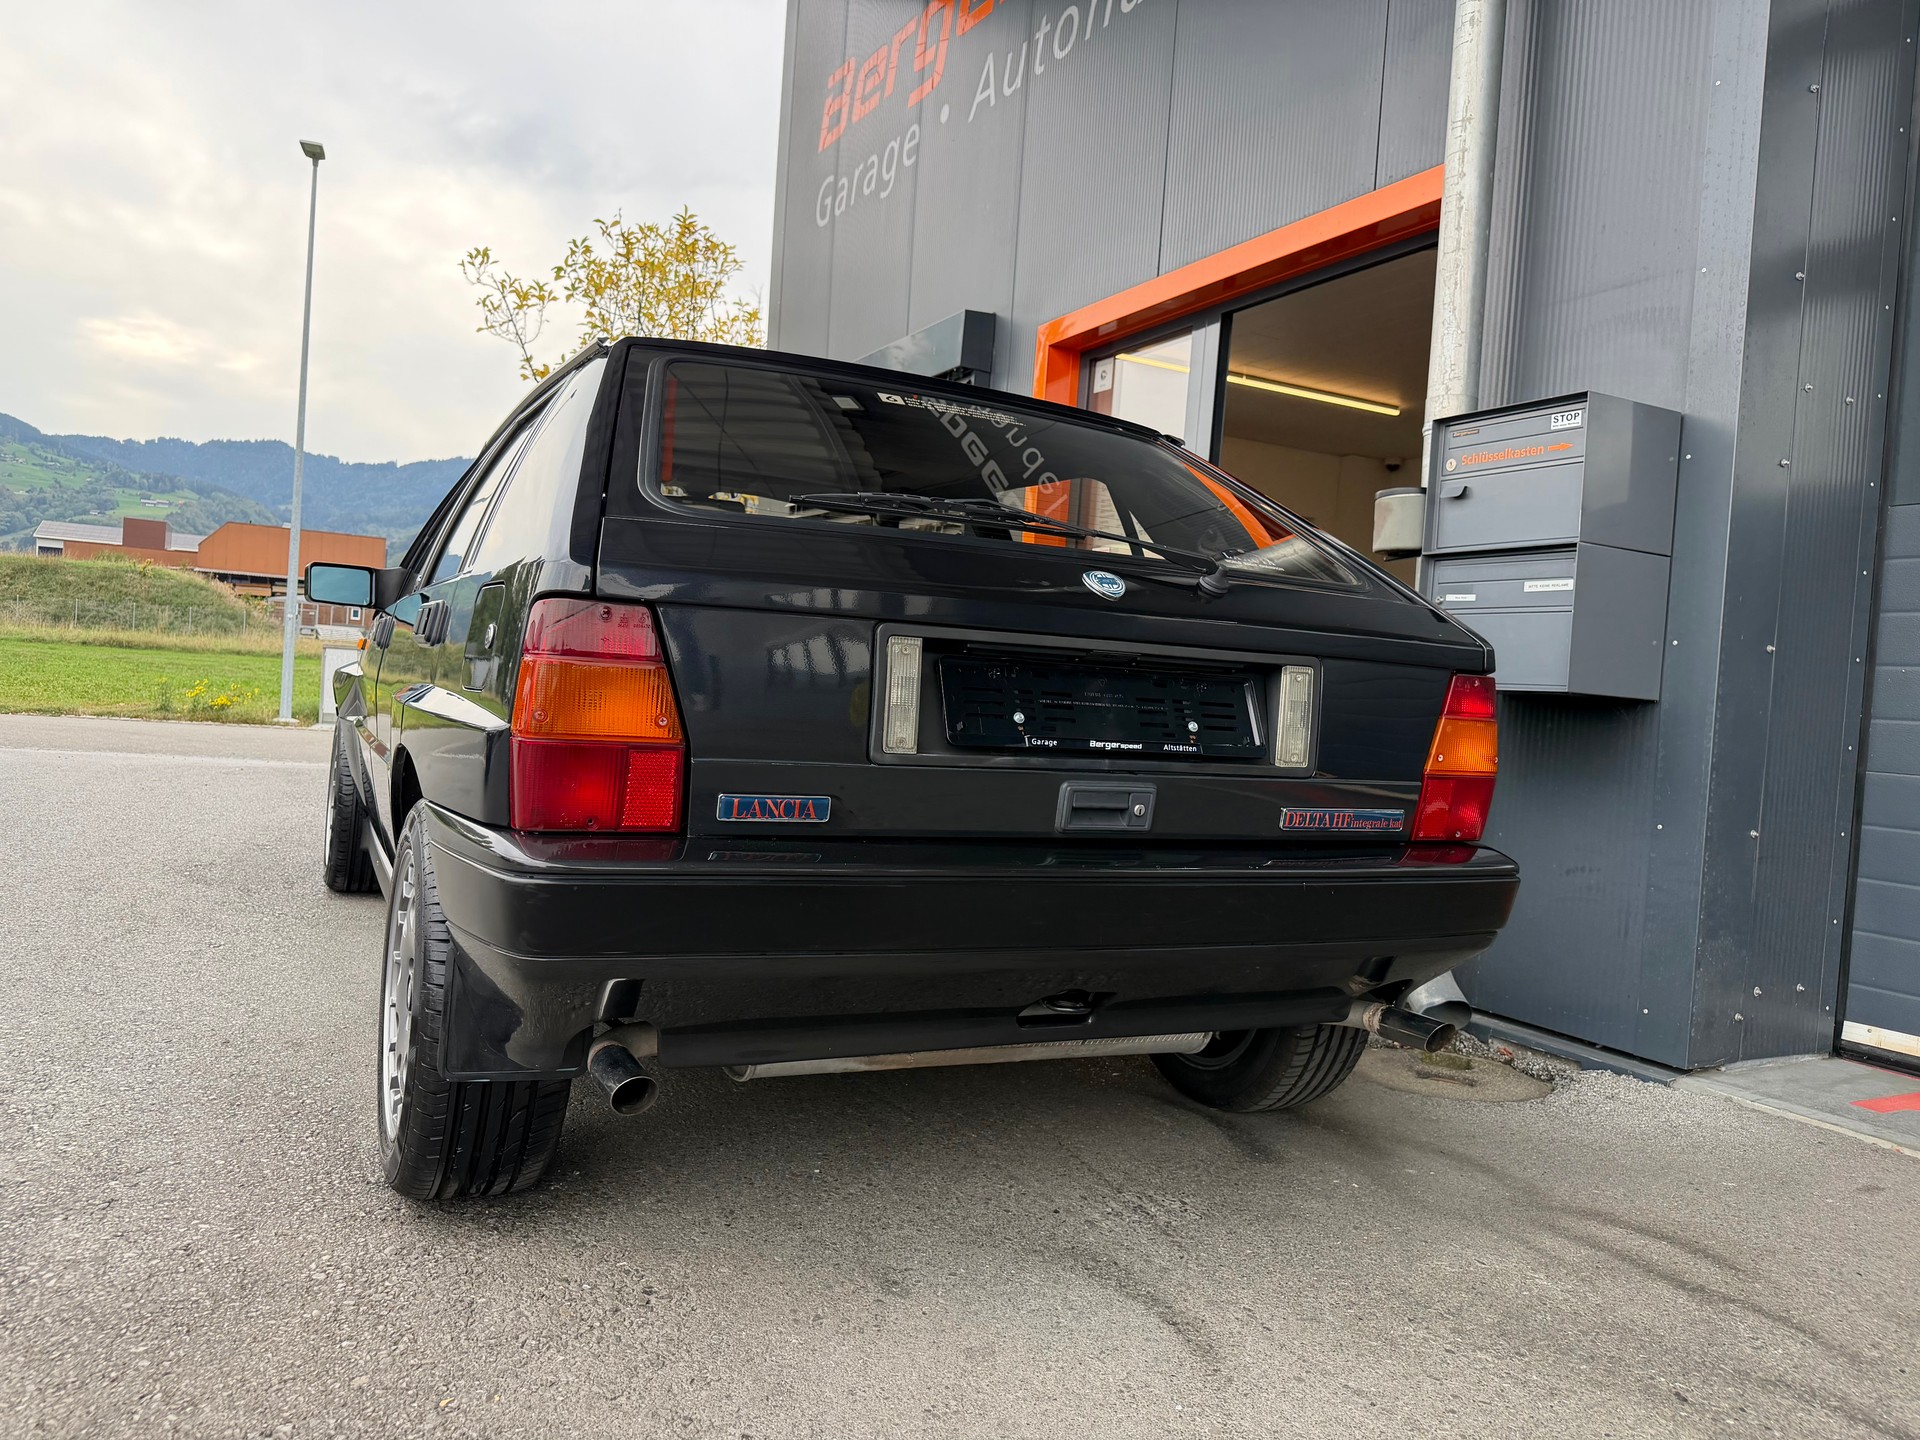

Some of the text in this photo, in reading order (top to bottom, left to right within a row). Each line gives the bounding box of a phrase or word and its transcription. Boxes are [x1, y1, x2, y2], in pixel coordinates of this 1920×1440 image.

[816, 123, 920, 227] Garage
[1553, 412, 1580, 424] STOP
[1461, 445, 1545, 465] Schlüsselkasten
[1031, 738, 1197, 752] Garage Bergerspeed Altstätten
[731, 797, 817, 819] LANCIA
[1284, 811, 1402, 829] DELTA HF integrale kat
